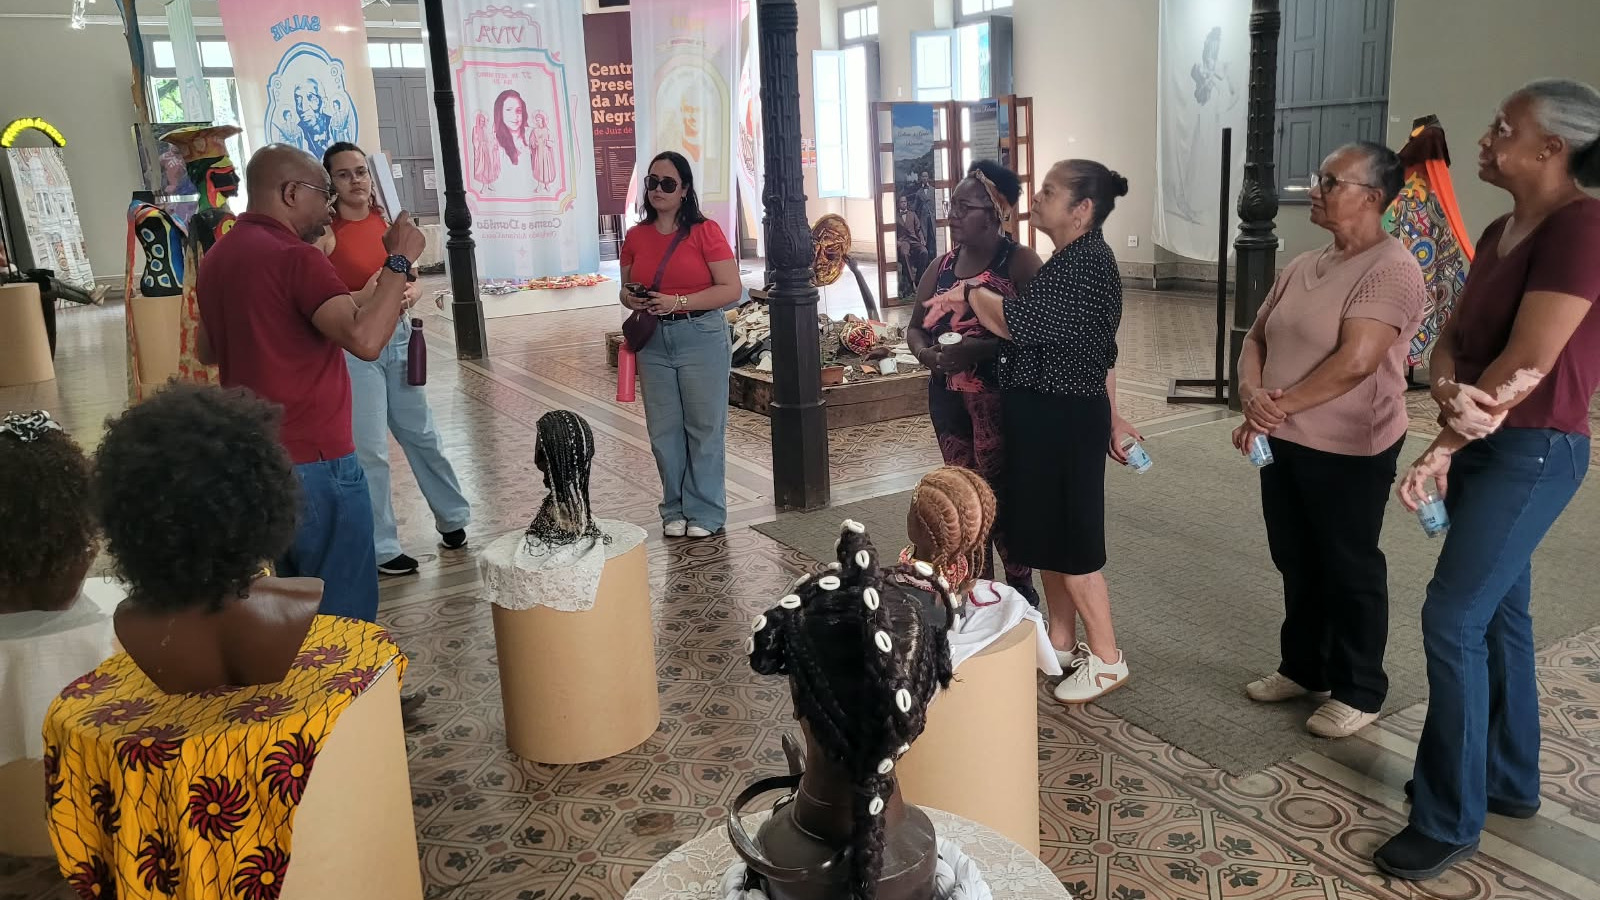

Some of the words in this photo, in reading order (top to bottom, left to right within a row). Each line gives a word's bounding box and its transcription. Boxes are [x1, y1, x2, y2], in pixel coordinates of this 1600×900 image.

[589, 63, 633, 76] Centr
[590, 78, 633, 92] Prese
[591, 94, 611, 108] da
[614, 93, 635, 106] Me
[594, 127, 604, 135] de
